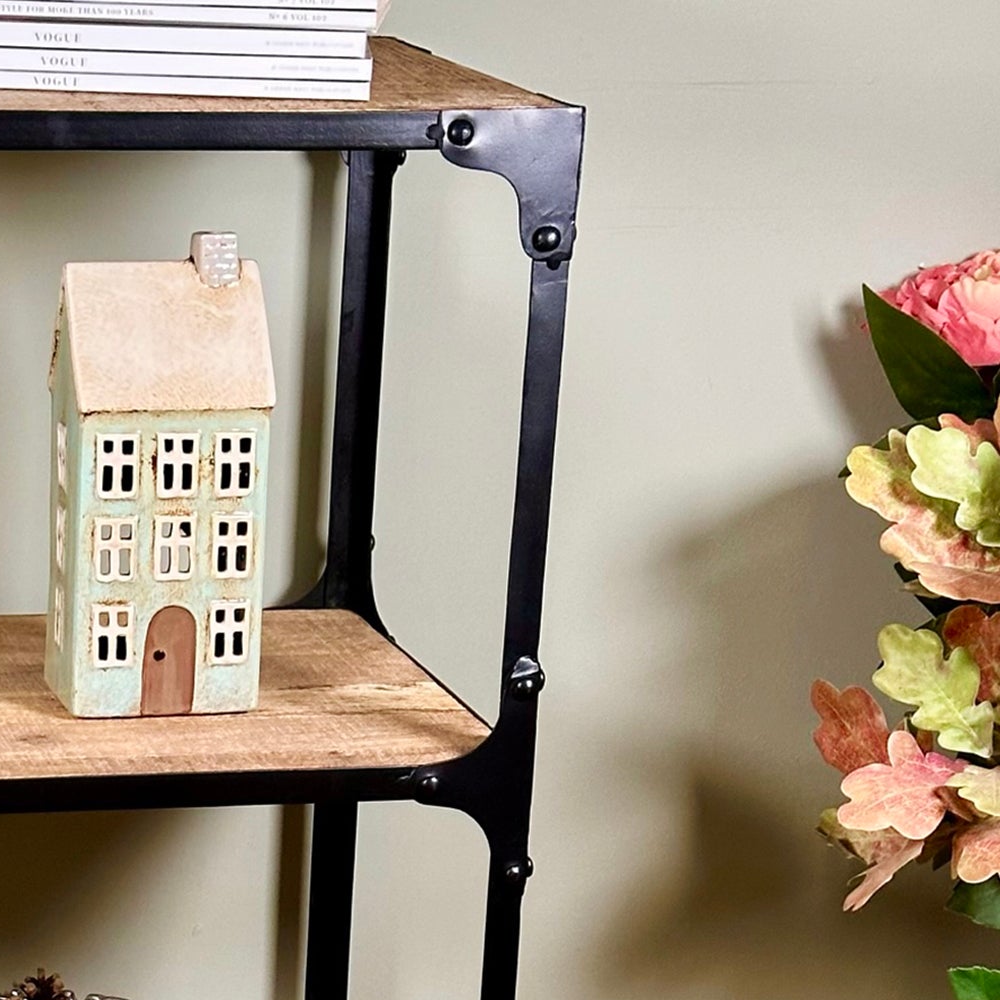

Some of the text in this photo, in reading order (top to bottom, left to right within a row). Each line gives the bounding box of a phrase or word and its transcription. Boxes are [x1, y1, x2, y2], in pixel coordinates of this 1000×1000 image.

[26, 5, 45, 13] FOR
[48, 6, 74, 14] MORE
[78, 7, 104, 15] THAN
[124, 8, 155, 16] YEARS
[291, 13, 309, 21] VOL
[35, 32, 80, 43] VOGUE
[41, 56, 87, 67] VOGUE
[33, 76, 79, 87] VOGUE
